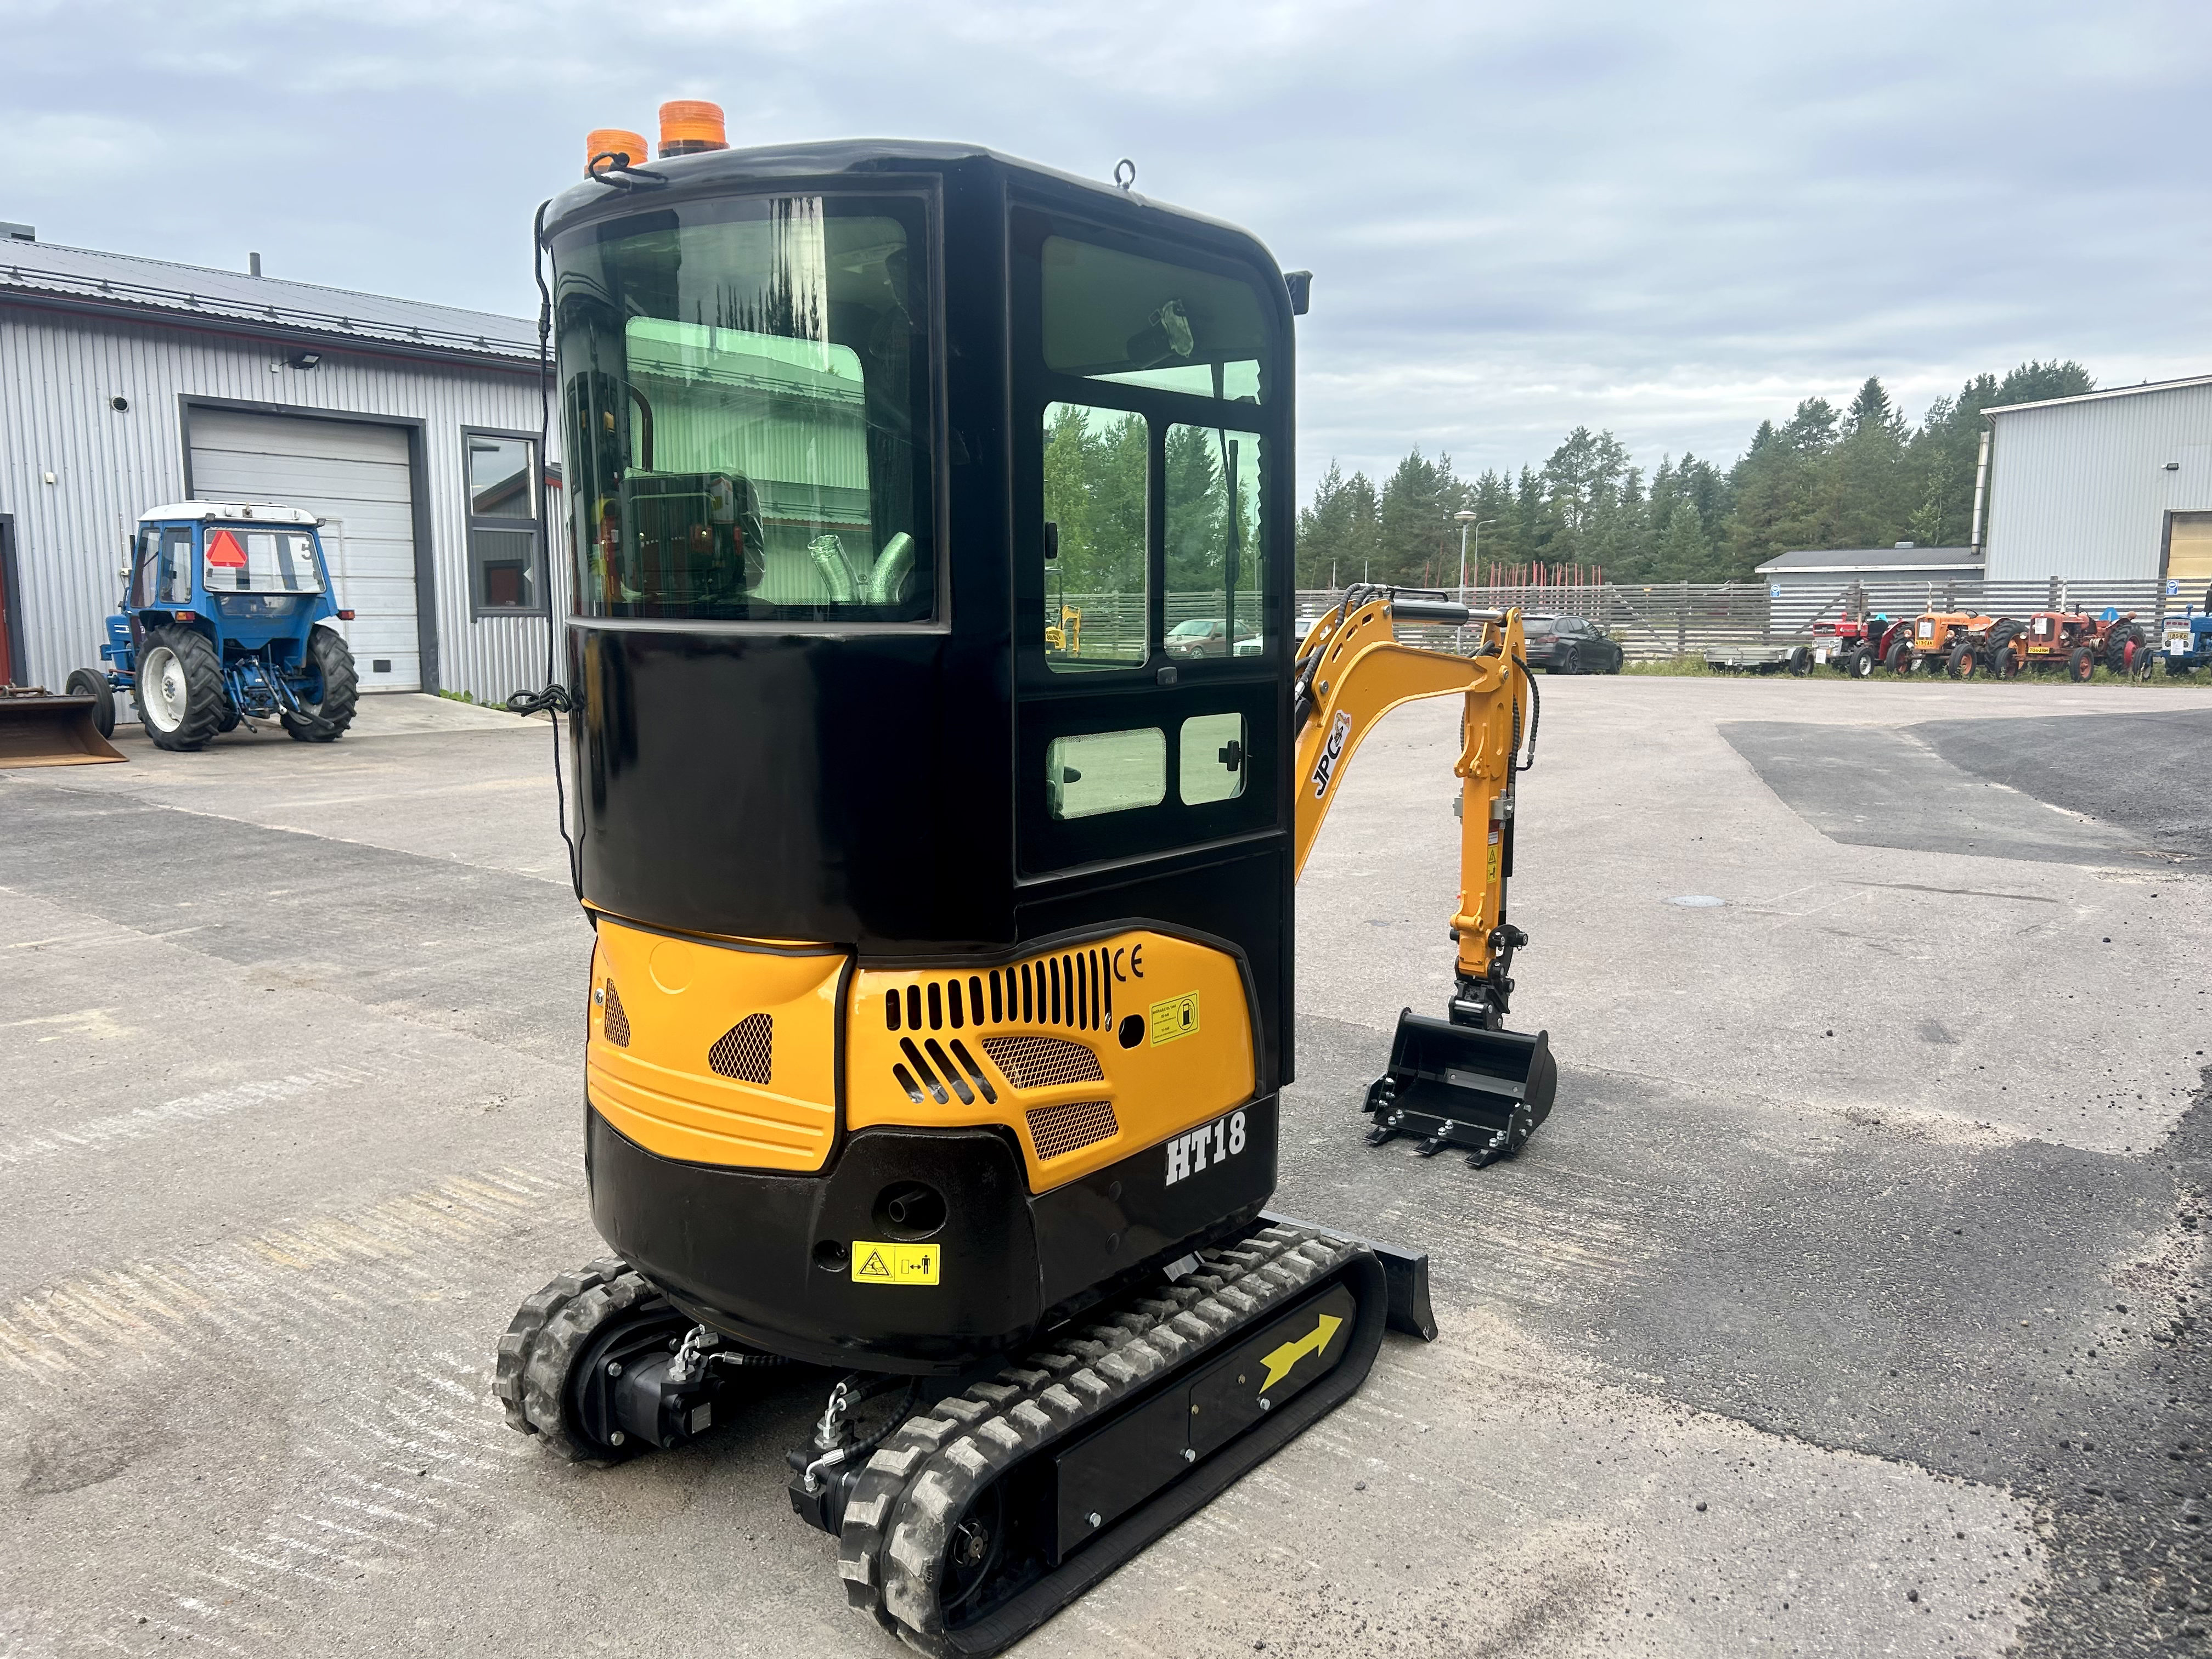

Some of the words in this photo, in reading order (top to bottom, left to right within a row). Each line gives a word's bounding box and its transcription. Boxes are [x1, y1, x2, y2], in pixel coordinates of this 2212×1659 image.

[1313, 733, 1342, 796] JPC
[1113, 943, 1144, 982] CE
[1166, 1111, 1246, 1187] HT18
